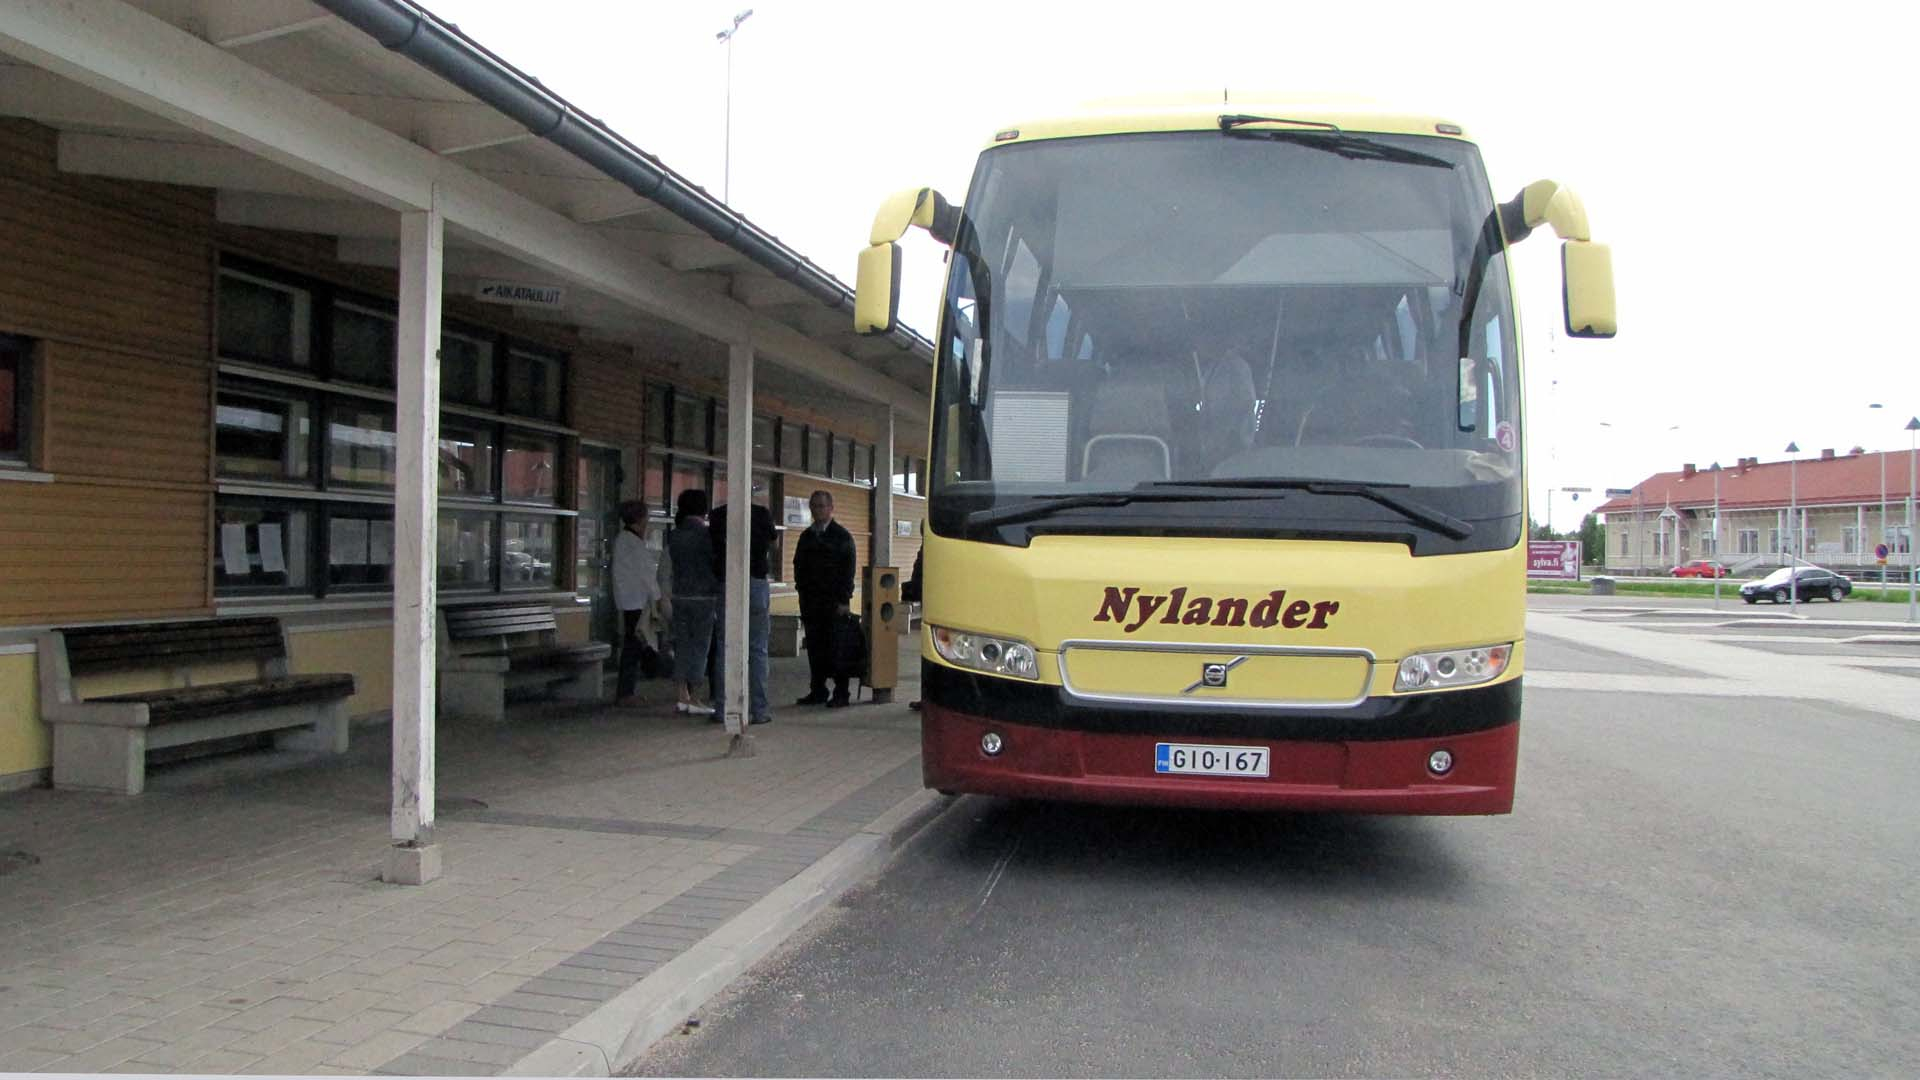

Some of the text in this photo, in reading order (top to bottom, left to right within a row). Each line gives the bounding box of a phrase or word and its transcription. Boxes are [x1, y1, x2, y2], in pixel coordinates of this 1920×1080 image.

[496, 285, 560, 304] AIKATAULUT
[1533, 557, 1559, 568] sylva.fi
[1093, 587, 1340, 633] Nylander
[1173, 749, 1262, 771] GIO-167
